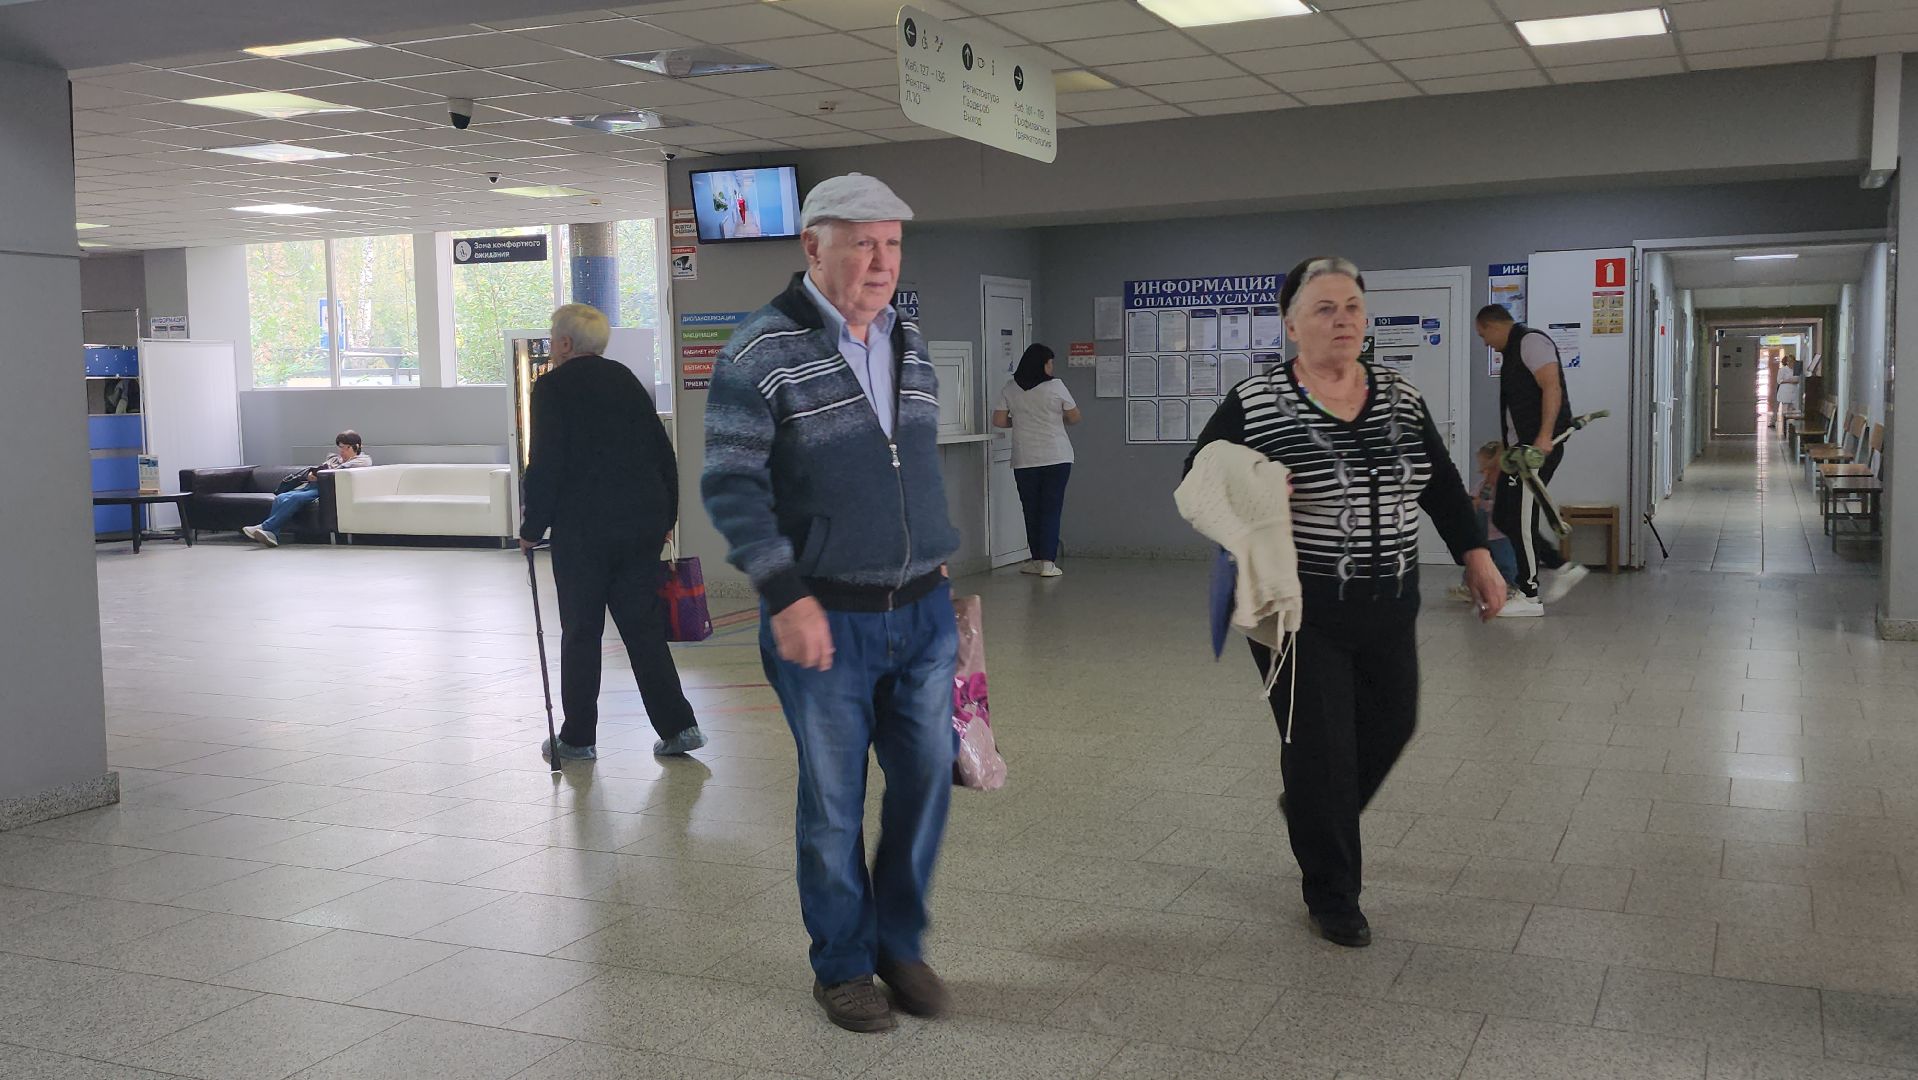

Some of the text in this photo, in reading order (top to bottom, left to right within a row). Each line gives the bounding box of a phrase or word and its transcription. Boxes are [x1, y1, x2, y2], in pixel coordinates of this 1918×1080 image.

[474, 240, 541, 249] Зона комфортного
[474, 251, 510, 259] ожидания
[1133, 276, 1276, 295] ИНФОРМАЦИЯ
[1133, 292, 1277, 307] О ПЛАТНЫХ УСЛУГАХ
